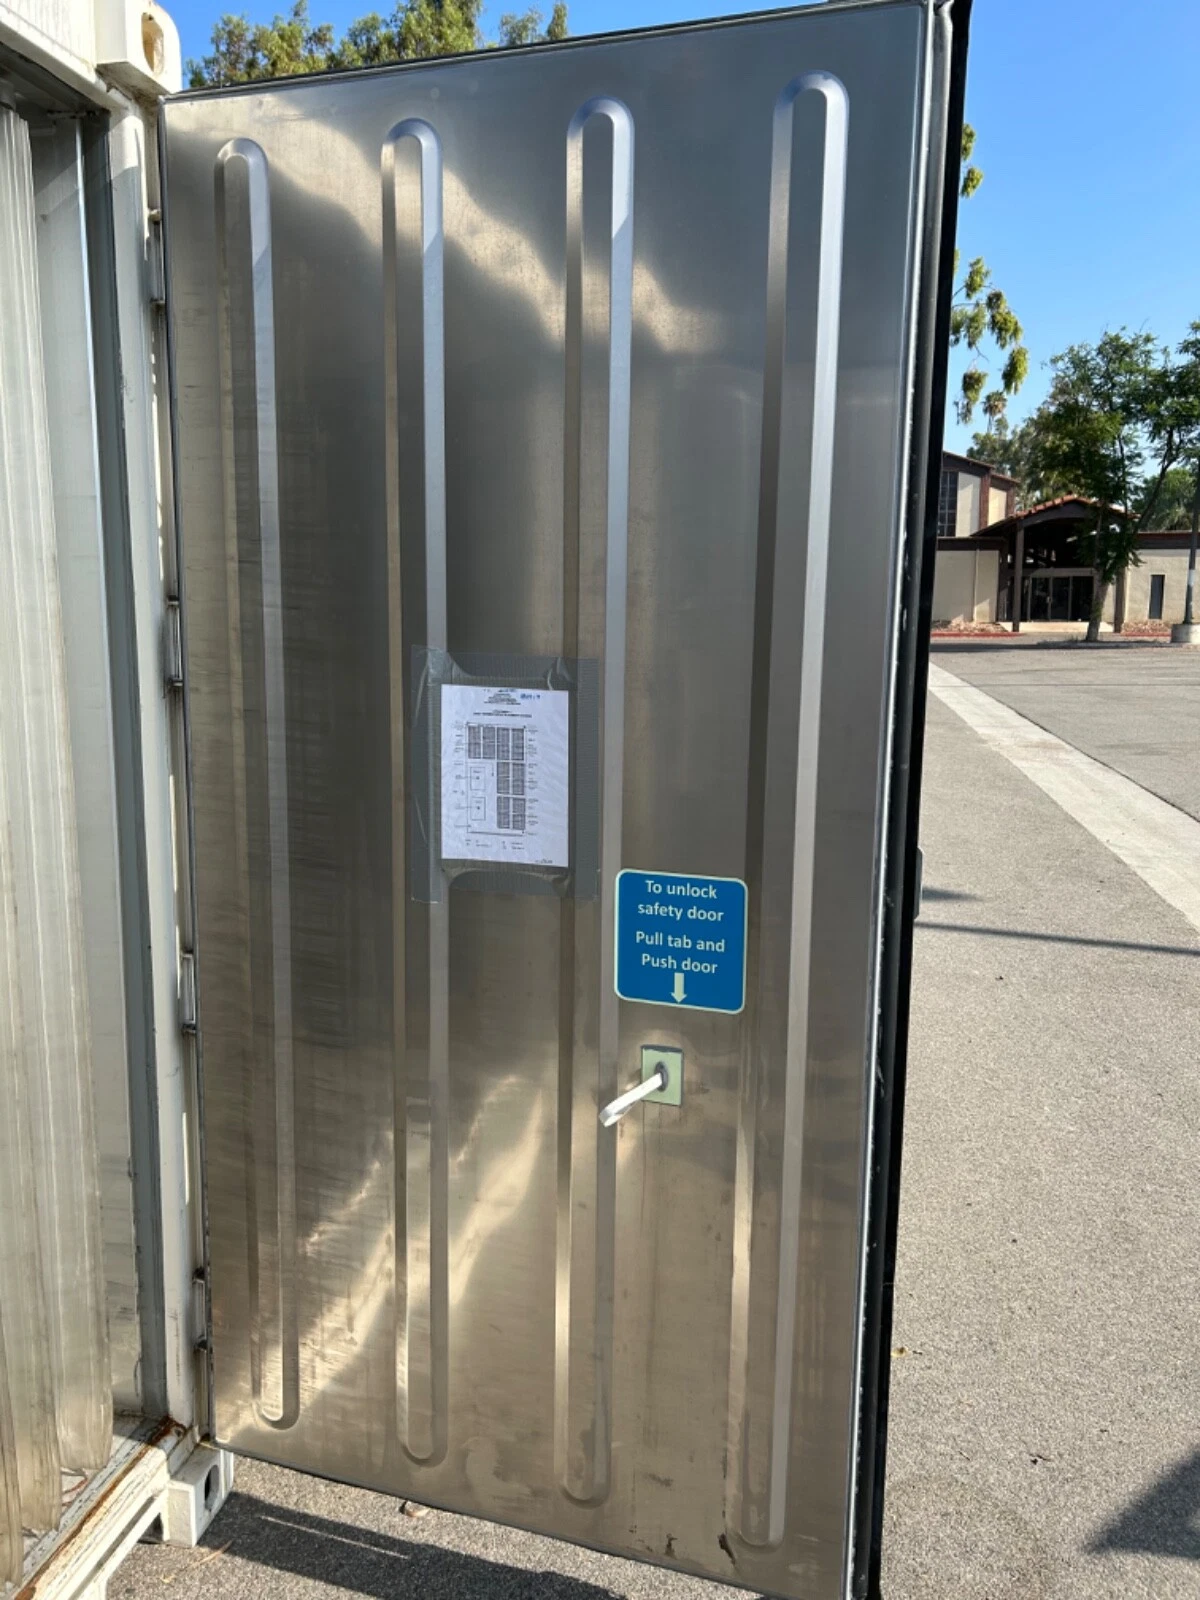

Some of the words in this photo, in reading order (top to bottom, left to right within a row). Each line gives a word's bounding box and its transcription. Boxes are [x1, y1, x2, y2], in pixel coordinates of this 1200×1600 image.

[645, 880, 662, 894] To
[667, 883, 717, 899] unlock
[638, 902, 683, 920] safety
[687, 906, 724, 921] door
[636, 931, 663, 946] Pull
[667, 935, 692, 948] tab
[696, 939, 725, 952] and
[642, 953, 677, 969] Push
[682, 957, 718, 974] door
